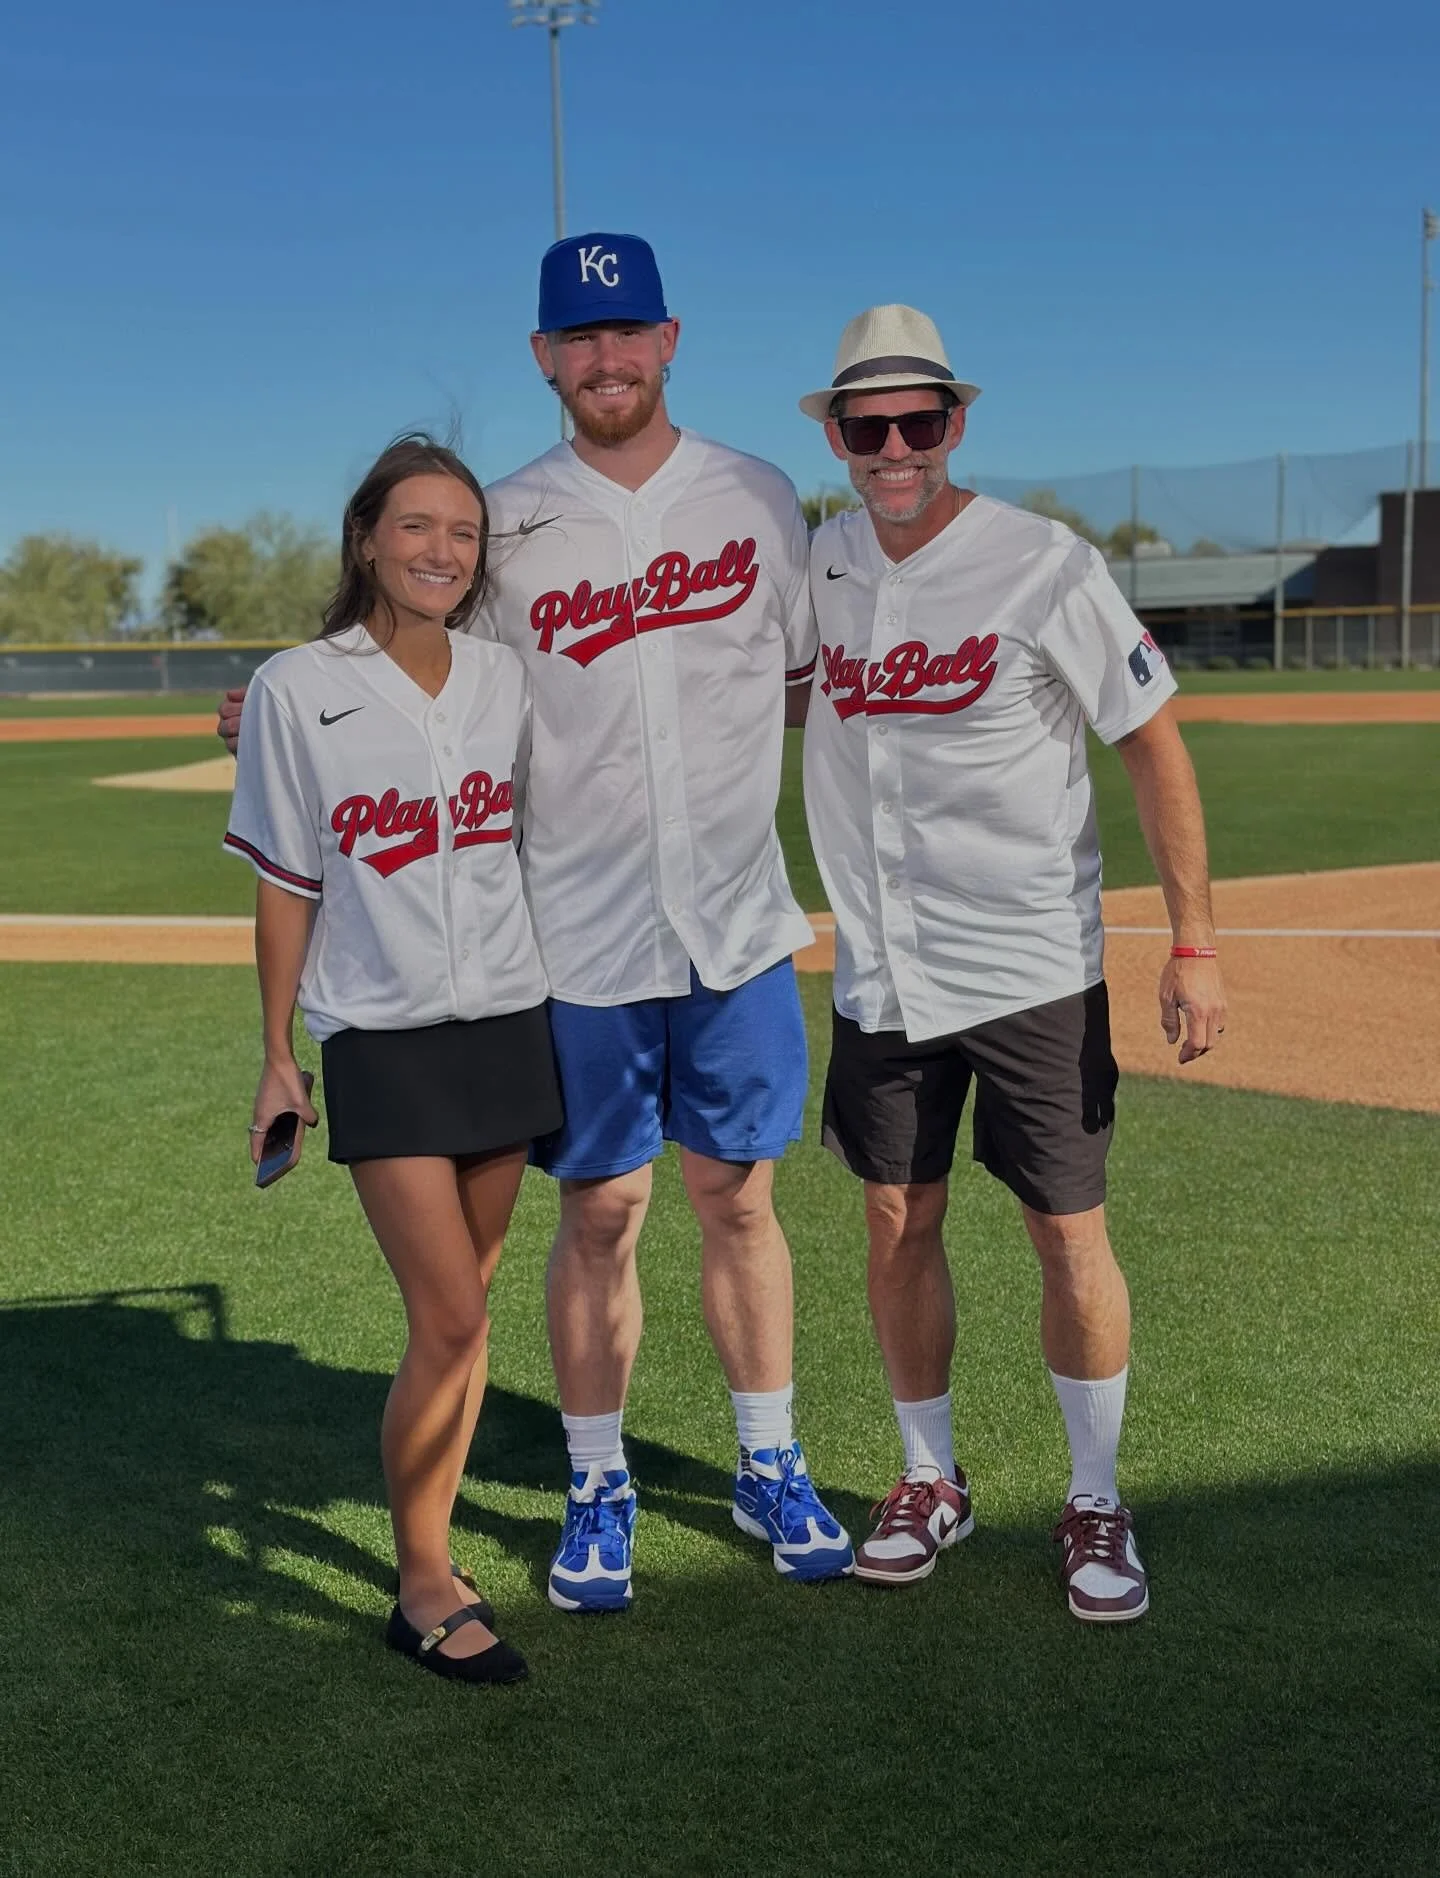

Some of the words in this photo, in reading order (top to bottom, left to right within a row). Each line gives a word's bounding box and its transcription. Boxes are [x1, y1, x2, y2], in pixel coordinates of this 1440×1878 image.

[578, 245, 619, 287] KC
[530, 577, 650, 655] Play
[646, 537, 759, 613] Ball
[878, 633, 999, 699] Ball
[331, 788, 464, 858] Play
[460, 770, 514, 830] Ba
